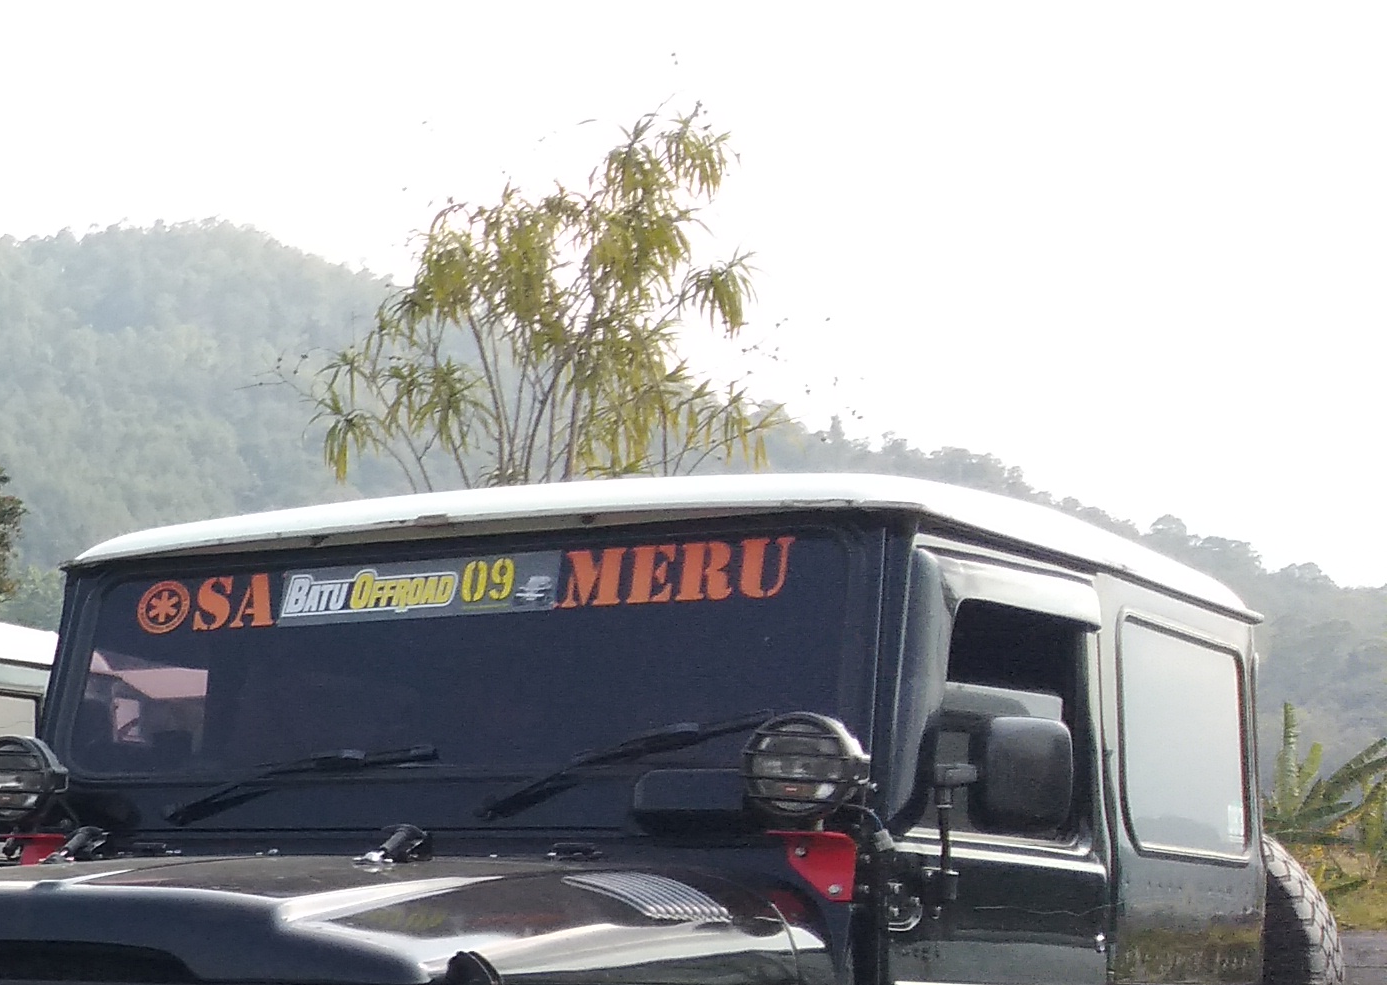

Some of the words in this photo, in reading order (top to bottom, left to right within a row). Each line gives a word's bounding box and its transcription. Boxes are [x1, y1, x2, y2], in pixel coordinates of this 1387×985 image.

[349, 572, 455, 611] OFFROAD
[461, 557, 516, 603] 09
[560, 536, 796, 609] MERU
